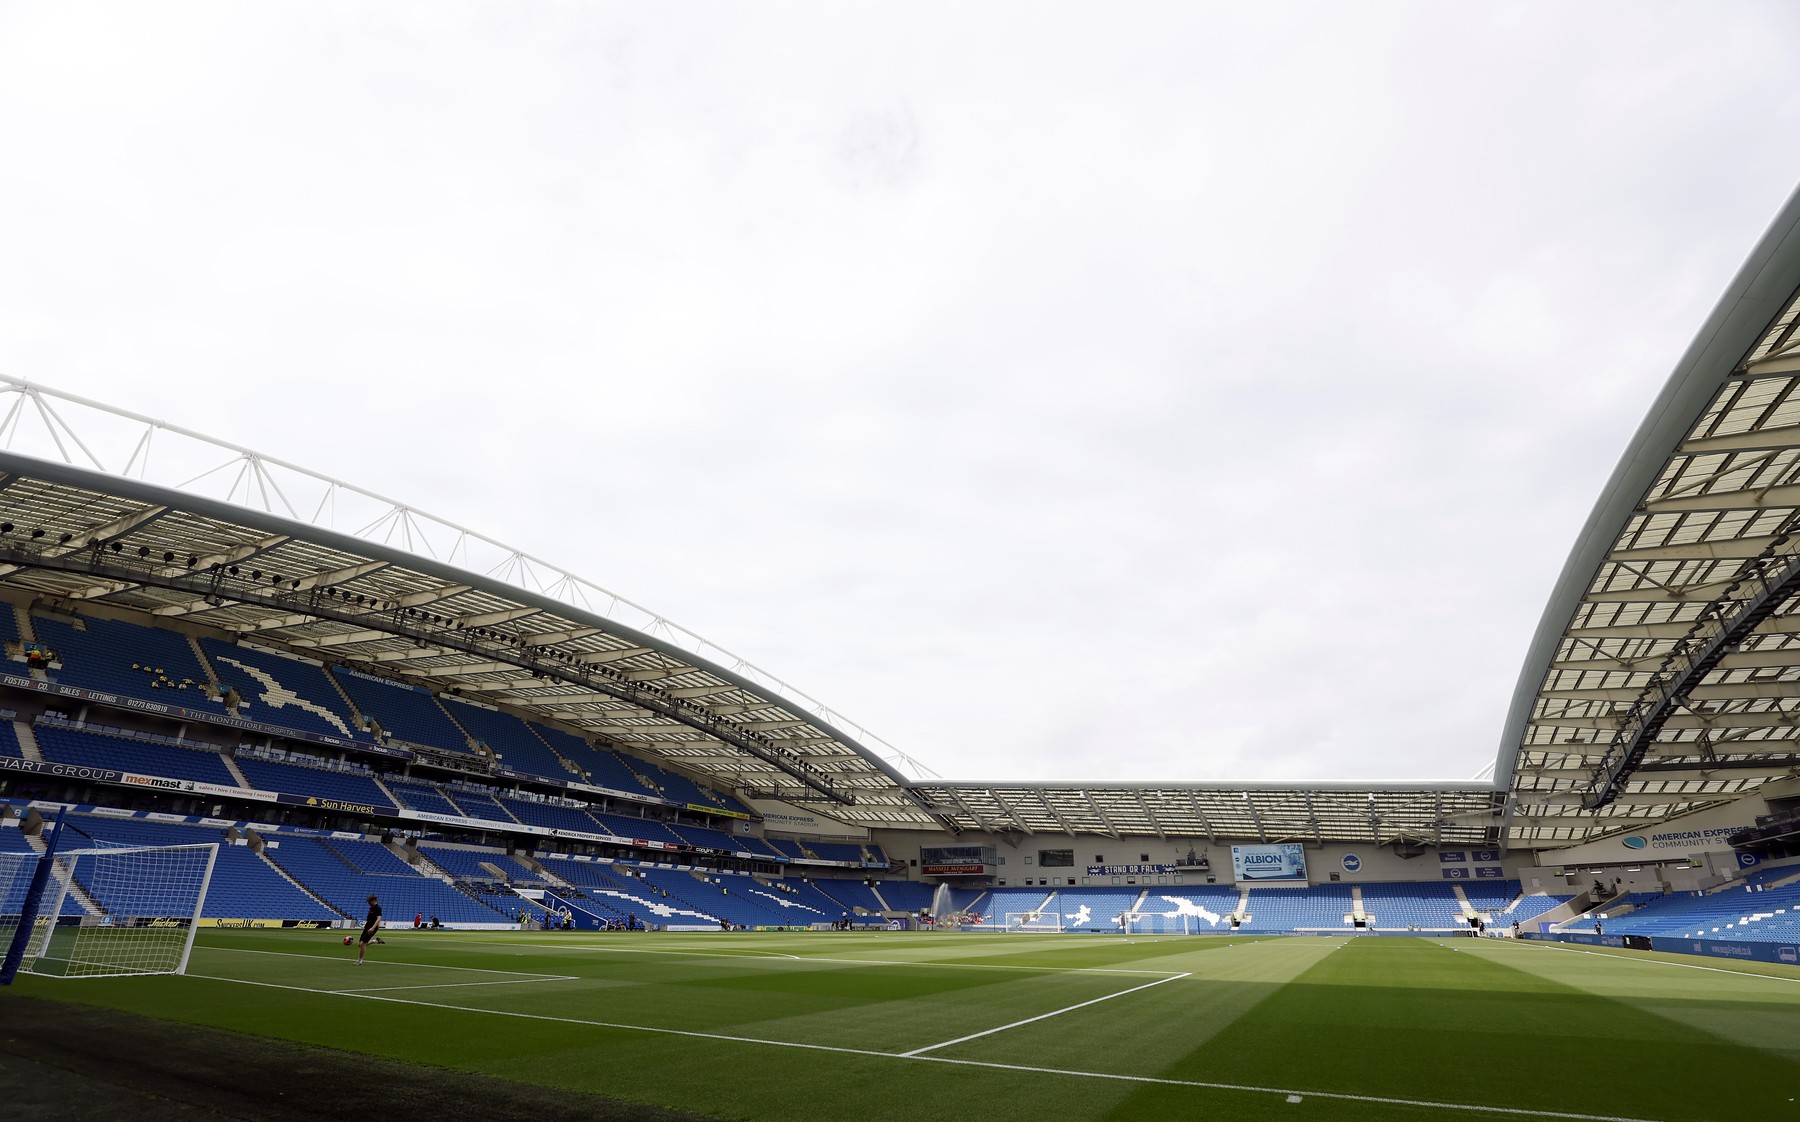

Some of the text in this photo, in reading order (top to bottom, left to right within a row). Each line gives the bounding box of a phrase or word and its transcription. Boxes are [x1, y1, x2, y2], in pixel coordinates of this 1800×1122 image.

[4, 676, 30, 687] FOSTER
[37, 682, 48, 691] CO.
[348, 670, 413, 691] AMERICAN EXPRESS
[60, 686, 80, 697] SALES
[88, 691, 117, 703] LETTINGS
[127, 699, 145, 709] 01273
[189, 711, 297, 737] THE MONTEFIORE HOSPITAL
[52, 765, 116, 780] GROUP
[125, 774, 182, 789] mexmast
[321, 799, 375, 814] Sun Harvest
[416, 813, 444, 821] AMERICAN
[468, 819, 501, 828] COMMUNITY
[1652, 830, 1700, 842] AMERICAN
[1652, 837, 1711, 849] COMMUNITY
[1244, 854, 1282, 864] ALBION
[1105, 865, 1159, 873] STAND OR FALL
